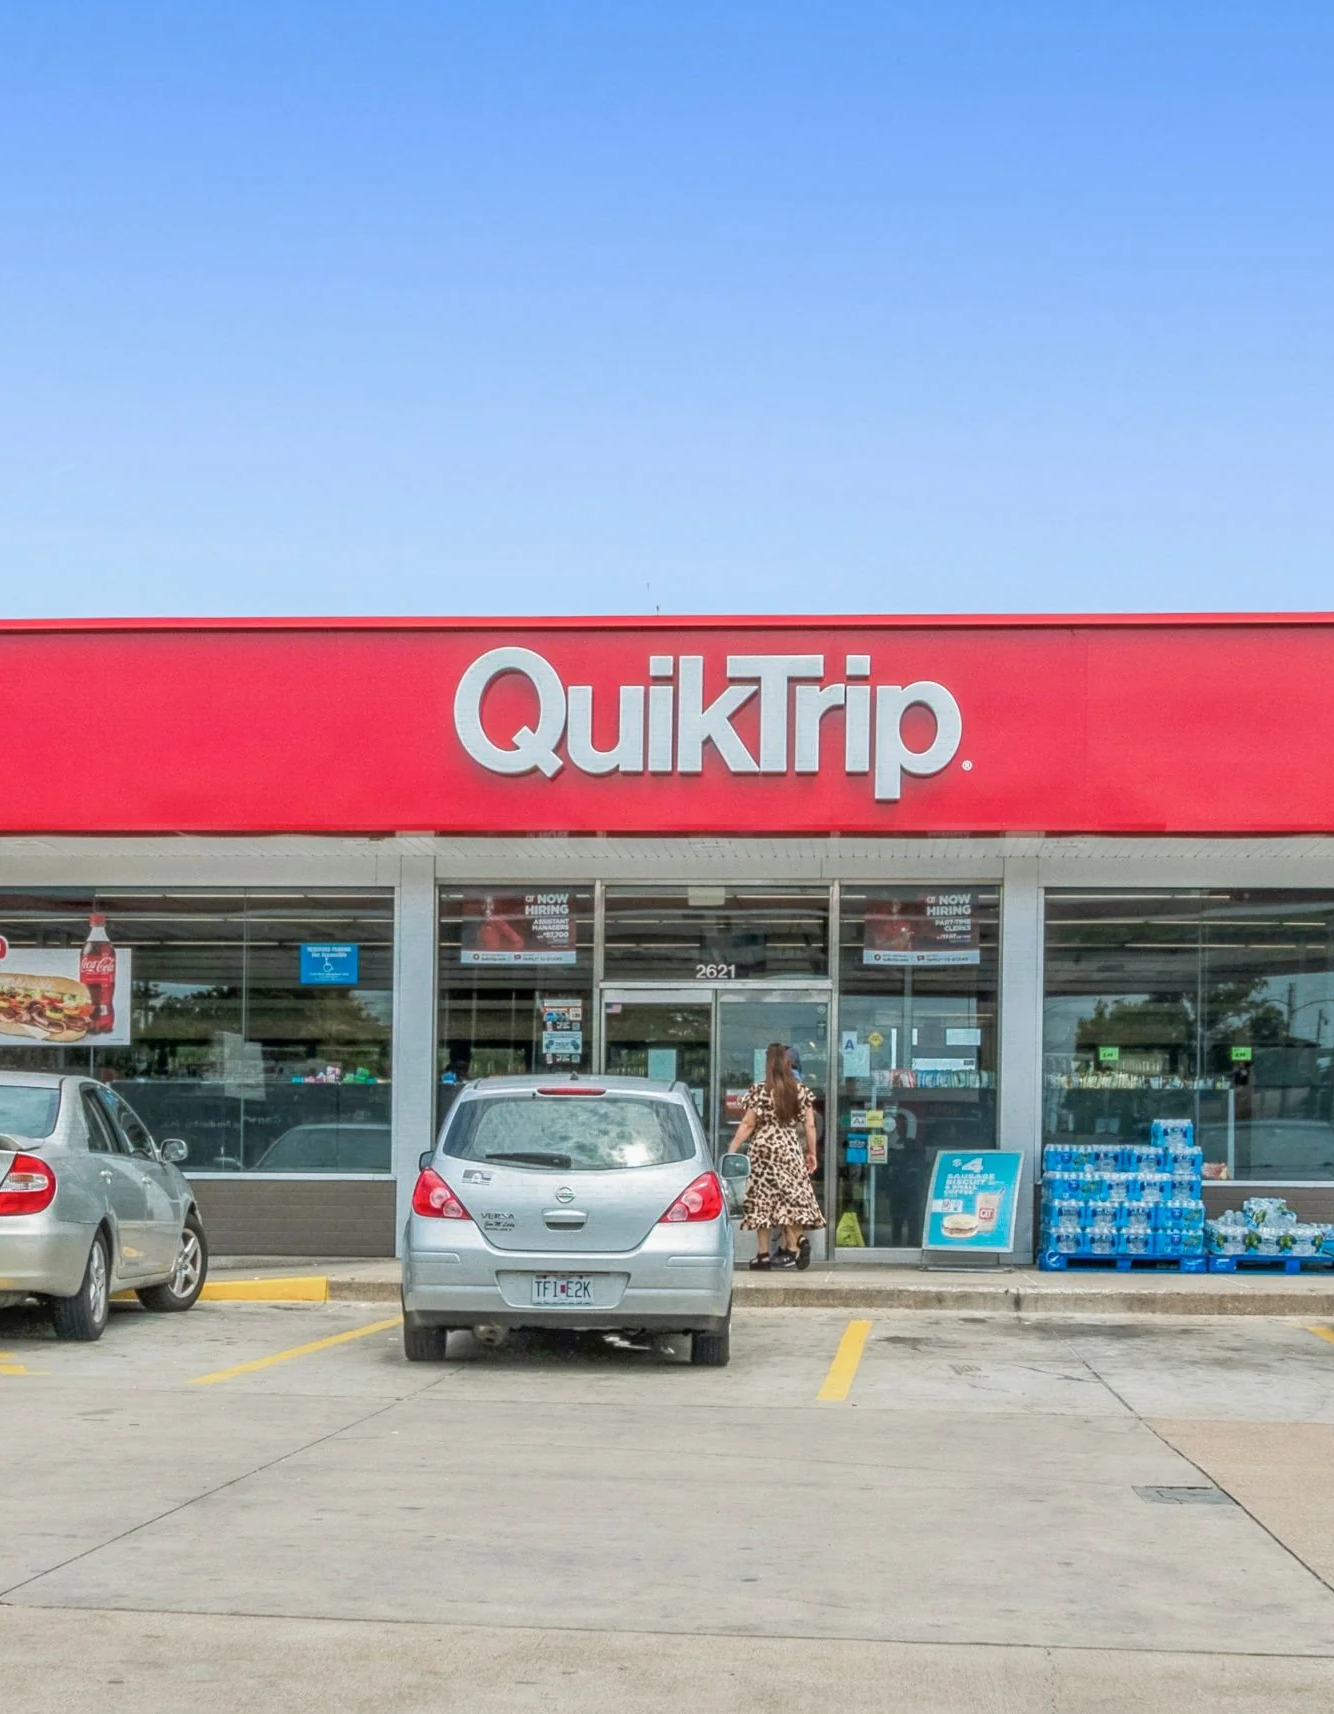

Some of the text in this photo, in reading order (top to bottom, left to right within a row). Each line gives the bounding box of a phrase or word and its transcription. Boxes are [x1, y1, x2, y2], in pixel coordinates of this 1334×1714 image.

[453, 646, 963, 802] QuikTrip
[537, 893, 569, 904] NOW
[939, 893, 971, 905] NOW
[525, 905, 569, 915] HIRING
[927, 905, 971, 916] HIRING
[695, 964, 736, 979] 2621
[844, 1039, 855, 1050] A
[535, 1281, 592, 1298] TF1 E2K
